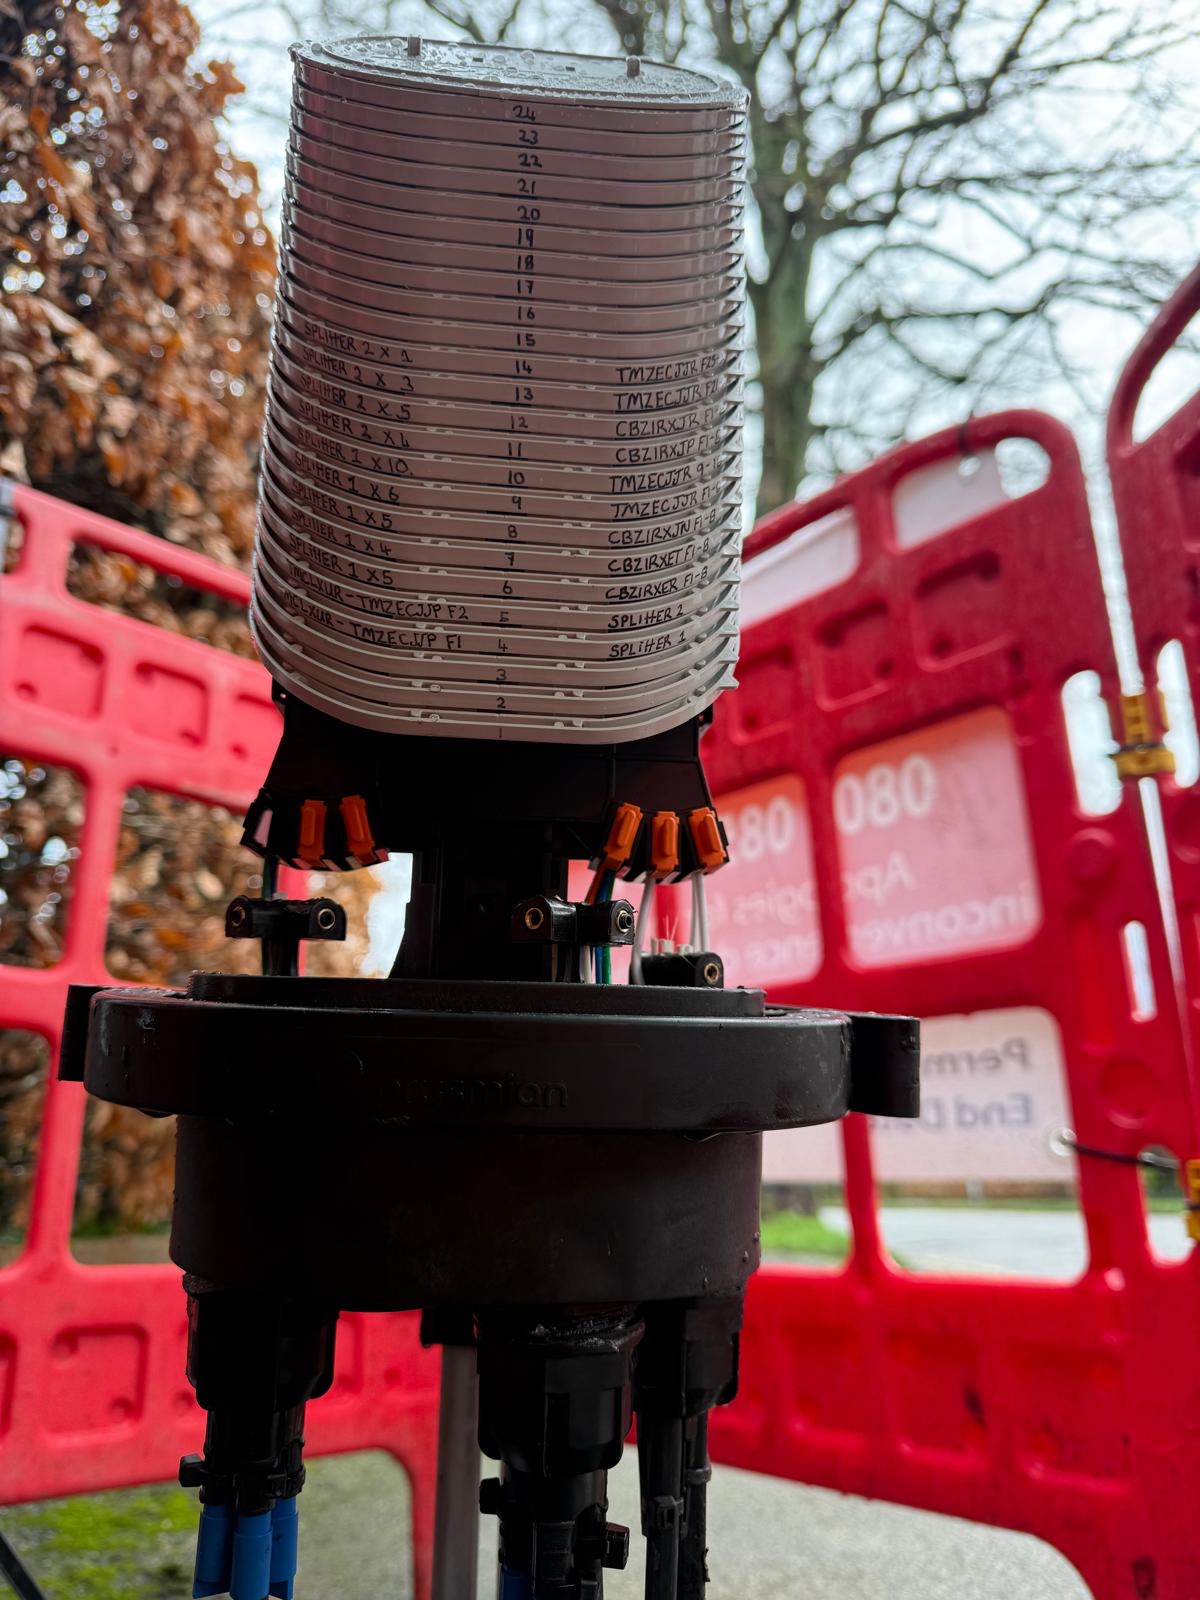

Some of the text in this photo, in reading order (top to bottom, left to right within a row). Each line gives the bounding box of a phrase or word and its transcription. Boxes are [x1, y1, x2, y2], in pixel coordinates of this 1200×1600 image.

[513, 105, 535, 121] 24
[519, 130, 539, 145] 23
[518, 153, 542, 168] 22
[517, 178, 536, 194] 21
[517, 205, 541, 221] 20
[518, 227, 534, 247] 19
[517, 279, 534, 294] 17
[518, 306, 535, 320] 16
[517, 333, 536, 346] 15
[362, 341, 375, 356] 2
[353, 366, 364, 381] 2
[516, 360, 532, 374] 14
[356, 395, 367, 411] 2
[396, 404, 411, 420] 5
[511, 415, 528, 429] 12
[360, 423, 373, 440] 2
[400, 432, 411, 448] 4
[508, 442, 521, 456] 11
[508, 470, 525, 485] 10
[347, 475, 359, 494] 1
[388, 485, 400, 502] 6
[512, 495, 521, 510] 9
[346, 504, 358, 521] 1
[380, 513, 393, 529] 5
[508, 525, 518, 538] 8
[344, 533, 357, 549] 1
[379, 543, 392, 556] 4
[505, 552, 514, 566] 7
[348, 562, 359, 579] 1
[381, 569, 394, 586] 5
[503, 580, 513, 594] 6
[447, 605, 469, 620] F2
[499, 611, 510, 622] 5
[676, 604, 684, 617] 2
[446, 634, 462, 650] F1
[678, 630, 687, 644] 1
[498, 639, 508, 651] 4
[496, 669, 507, 681] 3
[497, 697, 506, 708] 2
